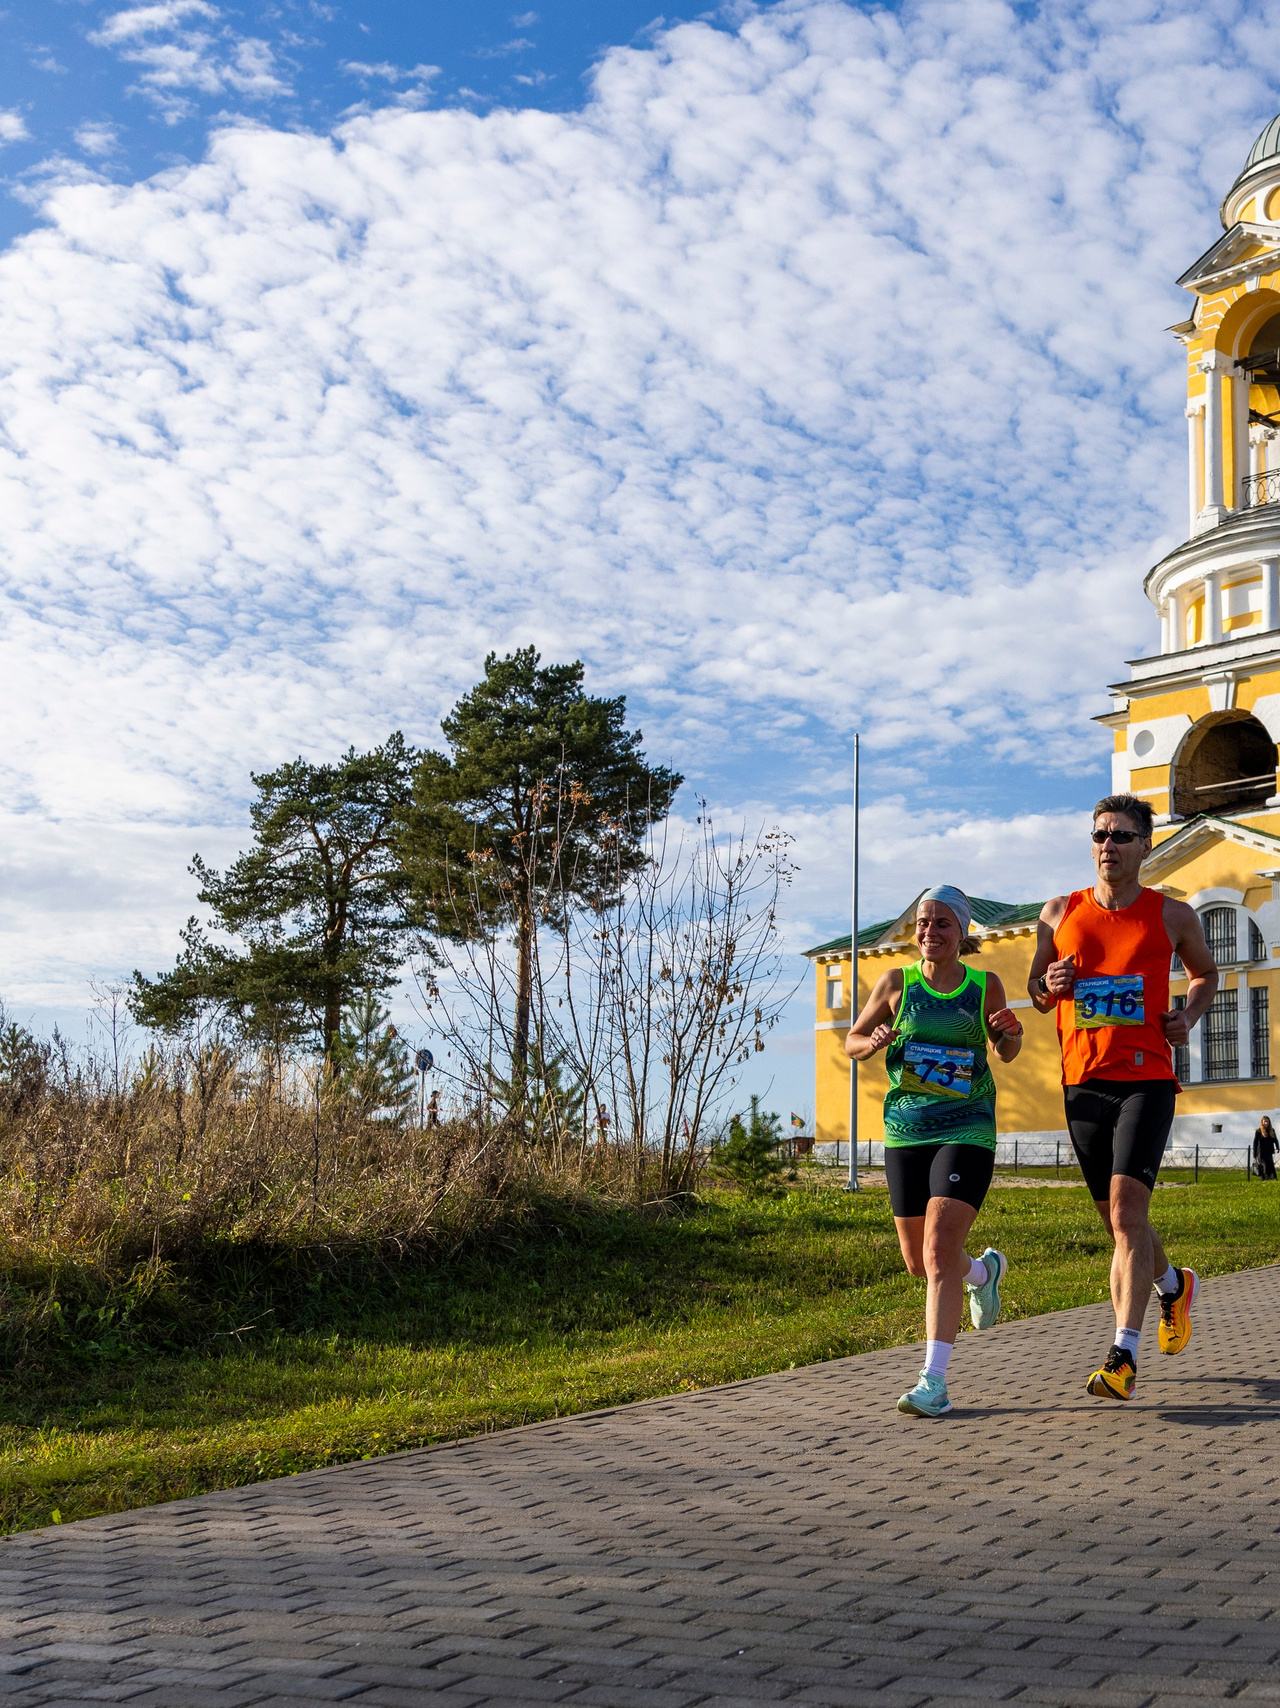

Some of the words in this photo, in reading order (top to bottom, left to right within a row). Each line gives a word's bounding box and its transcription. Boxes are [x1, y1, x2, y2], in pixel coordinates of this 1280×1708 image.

[1078, 979, 1110, 988] СТАРИЦКИЕ
[1081, 989, 1137, 1019] 316
[910, 1045, 942, 1055] СТАРИЦКИЕ
[920, 1058, 957, 1087] 73
